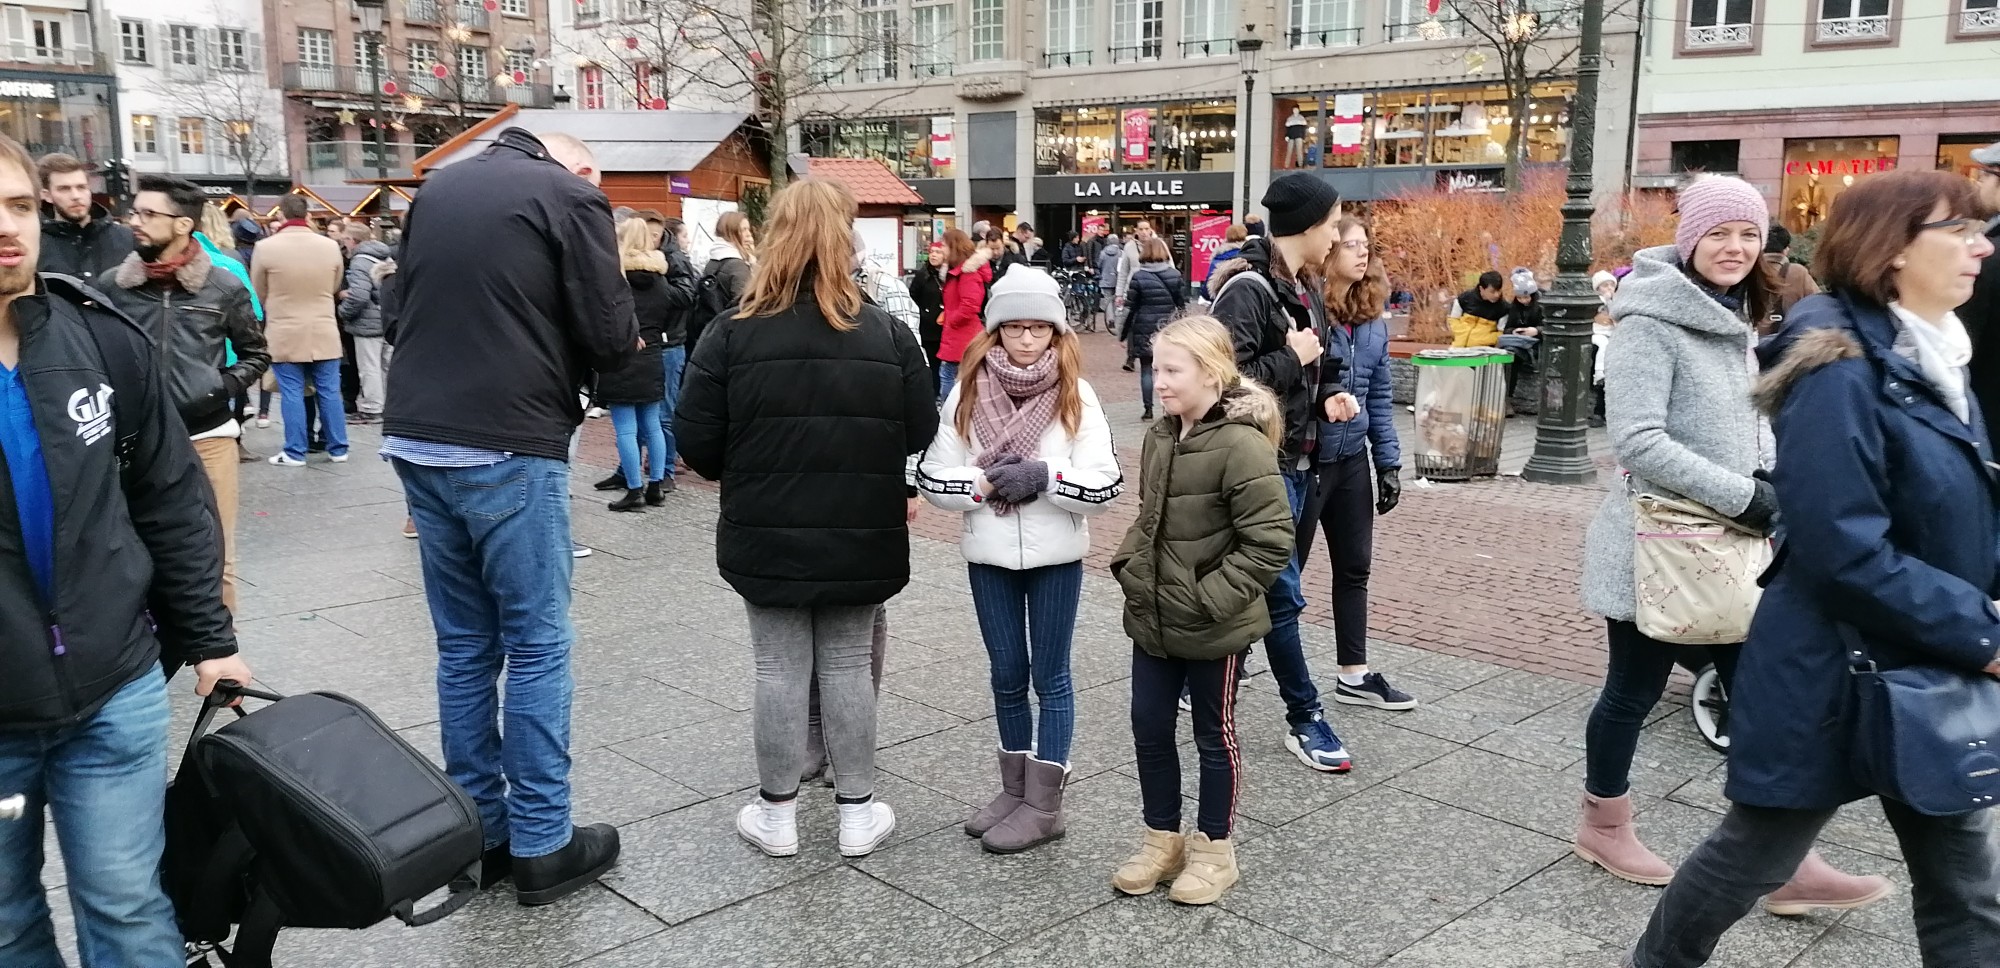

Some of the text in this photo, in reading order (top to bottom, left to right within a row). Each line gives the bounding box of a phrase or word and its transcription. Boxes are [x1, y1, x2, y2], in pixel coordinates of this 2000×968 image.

[0, 81, 56, 98] OIFFURE
[840, 123, 889, 134] LA HALLE
[1036, 122, 1061, 136] MEN
[1074, 180, 1184, 197] LA HALLE
[1448, 171, 1476, 194] MAD
[1194, 238, 1224, 252] -70
